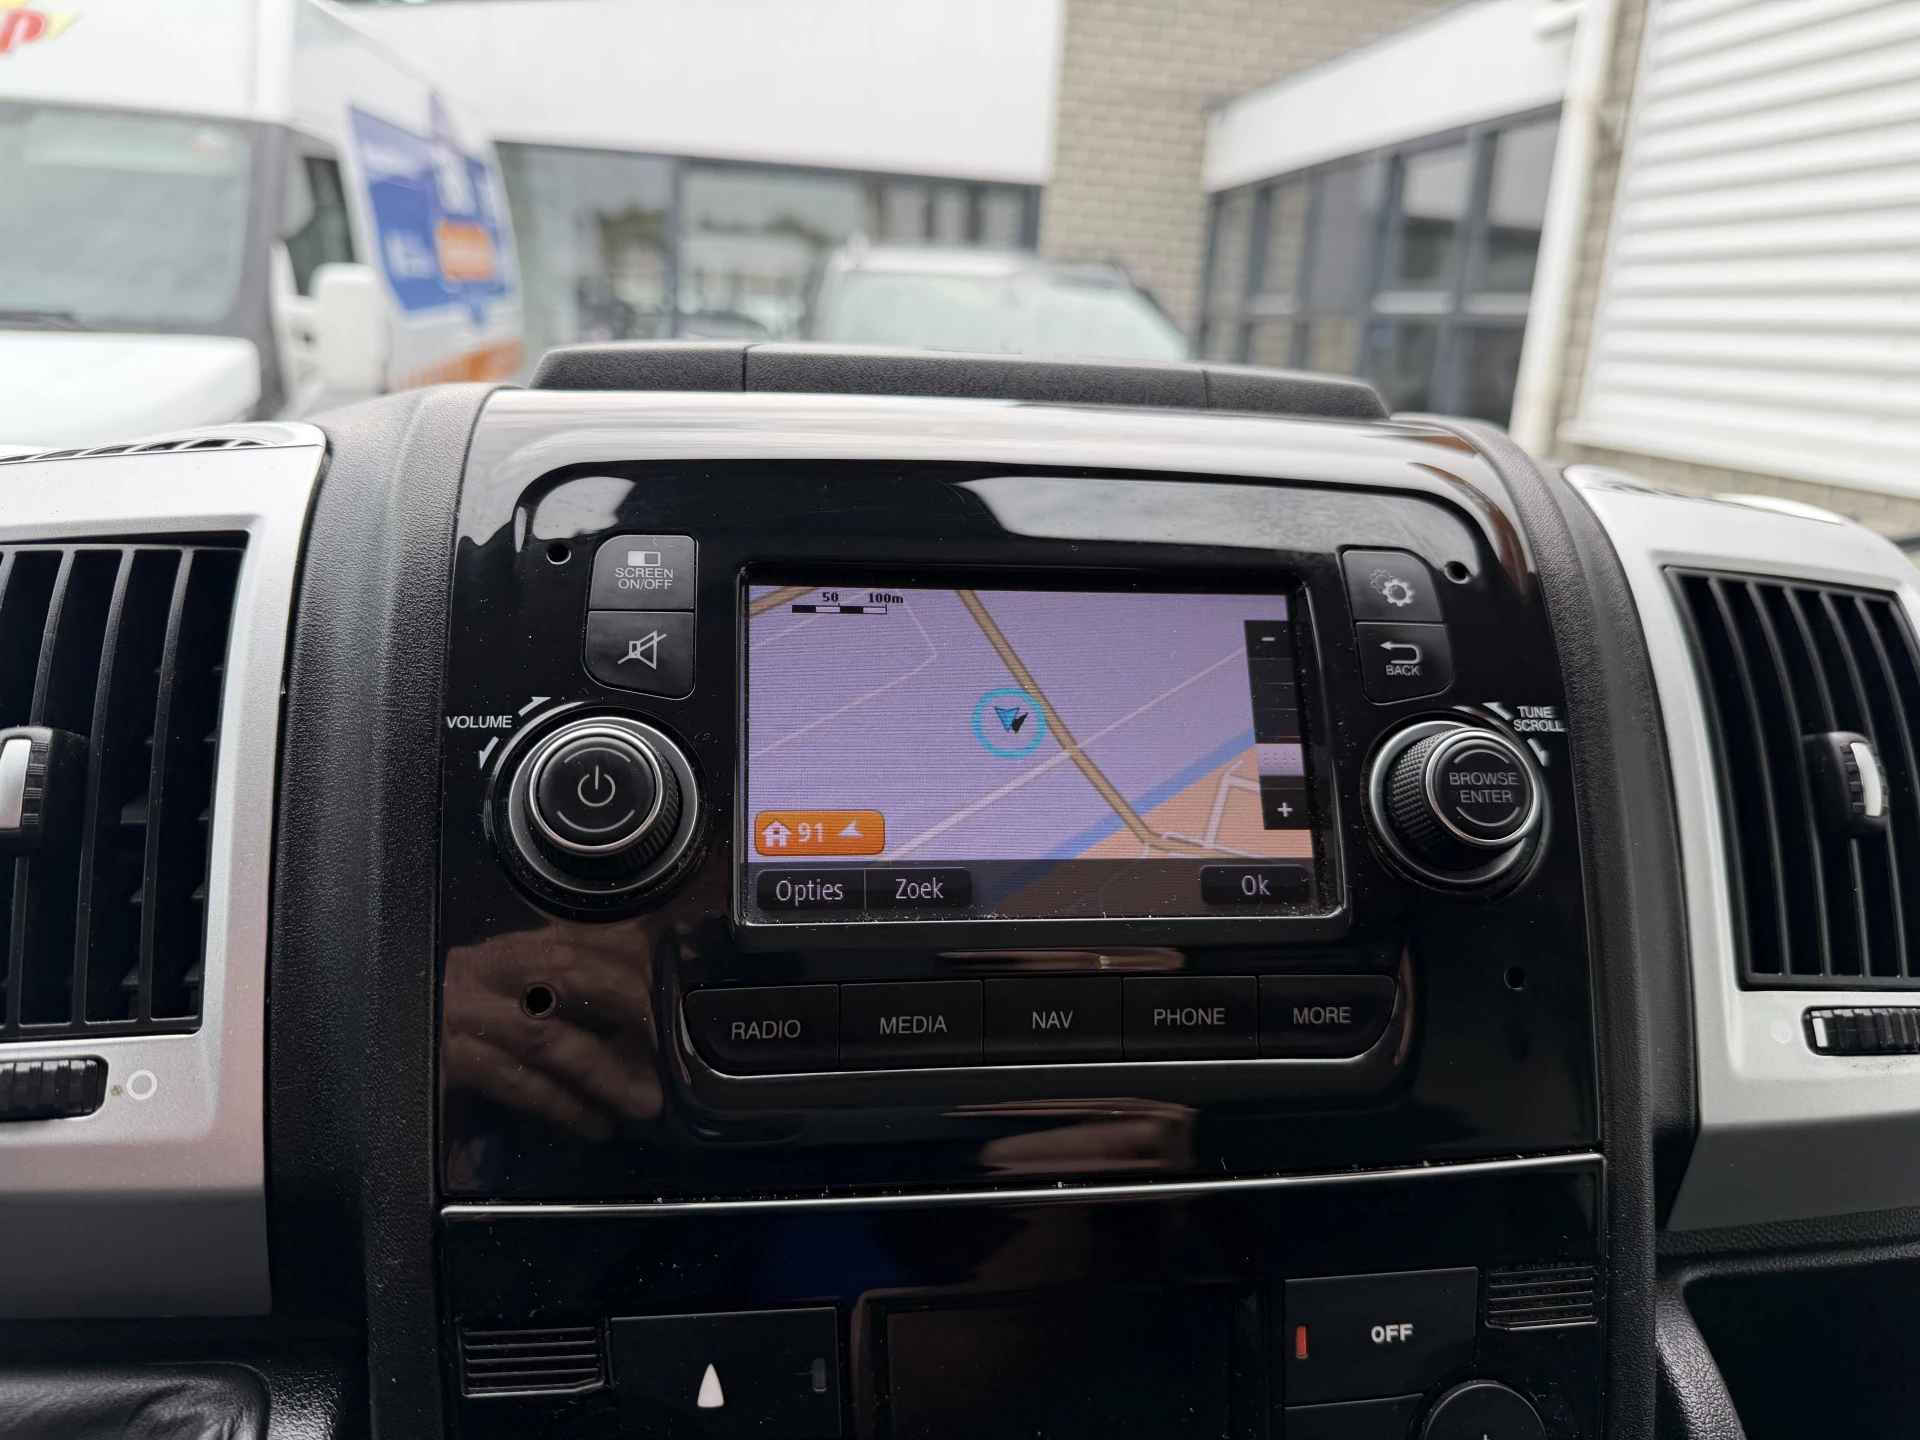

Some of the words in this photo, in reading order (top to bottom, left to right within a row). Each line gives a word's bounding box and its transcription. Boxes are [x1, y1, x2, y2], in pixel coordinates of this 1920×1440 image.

[615, 567, 674, 579] SCREEN
[618, 579, 672, 589] ON/OFF
[823, 592, 839, 602] 50
[869, 592, 904, 604] 100m
[1385, 665, 1421, 676] BACK
[1517, 705, 1554, 718] TUNE
[446, 715, 512, 728] VOLUME
[1513, 719, 1565, 732] SCROLL
[1449, 771, 1518, 785] BROWSE
[1460, 790, 1513, 803] ENTER
[798, 823, 824, 842] 91
[775, 880, 844, 906] Opties
[895, 877, 944, 900] Zoek
[1241, 875, 1271, 897] Ok
[879, 1014, 948, 1035] MEDIA
[1031, 1010, 1073, 1030] NAV
[1153, 1008, 1226, 1027] PHONE
[1292, 1006, 1352, 1026] MORE
[731, 1019, 802, 1041] RADIO
[1370, 1323, 1414, 1343] OFF
